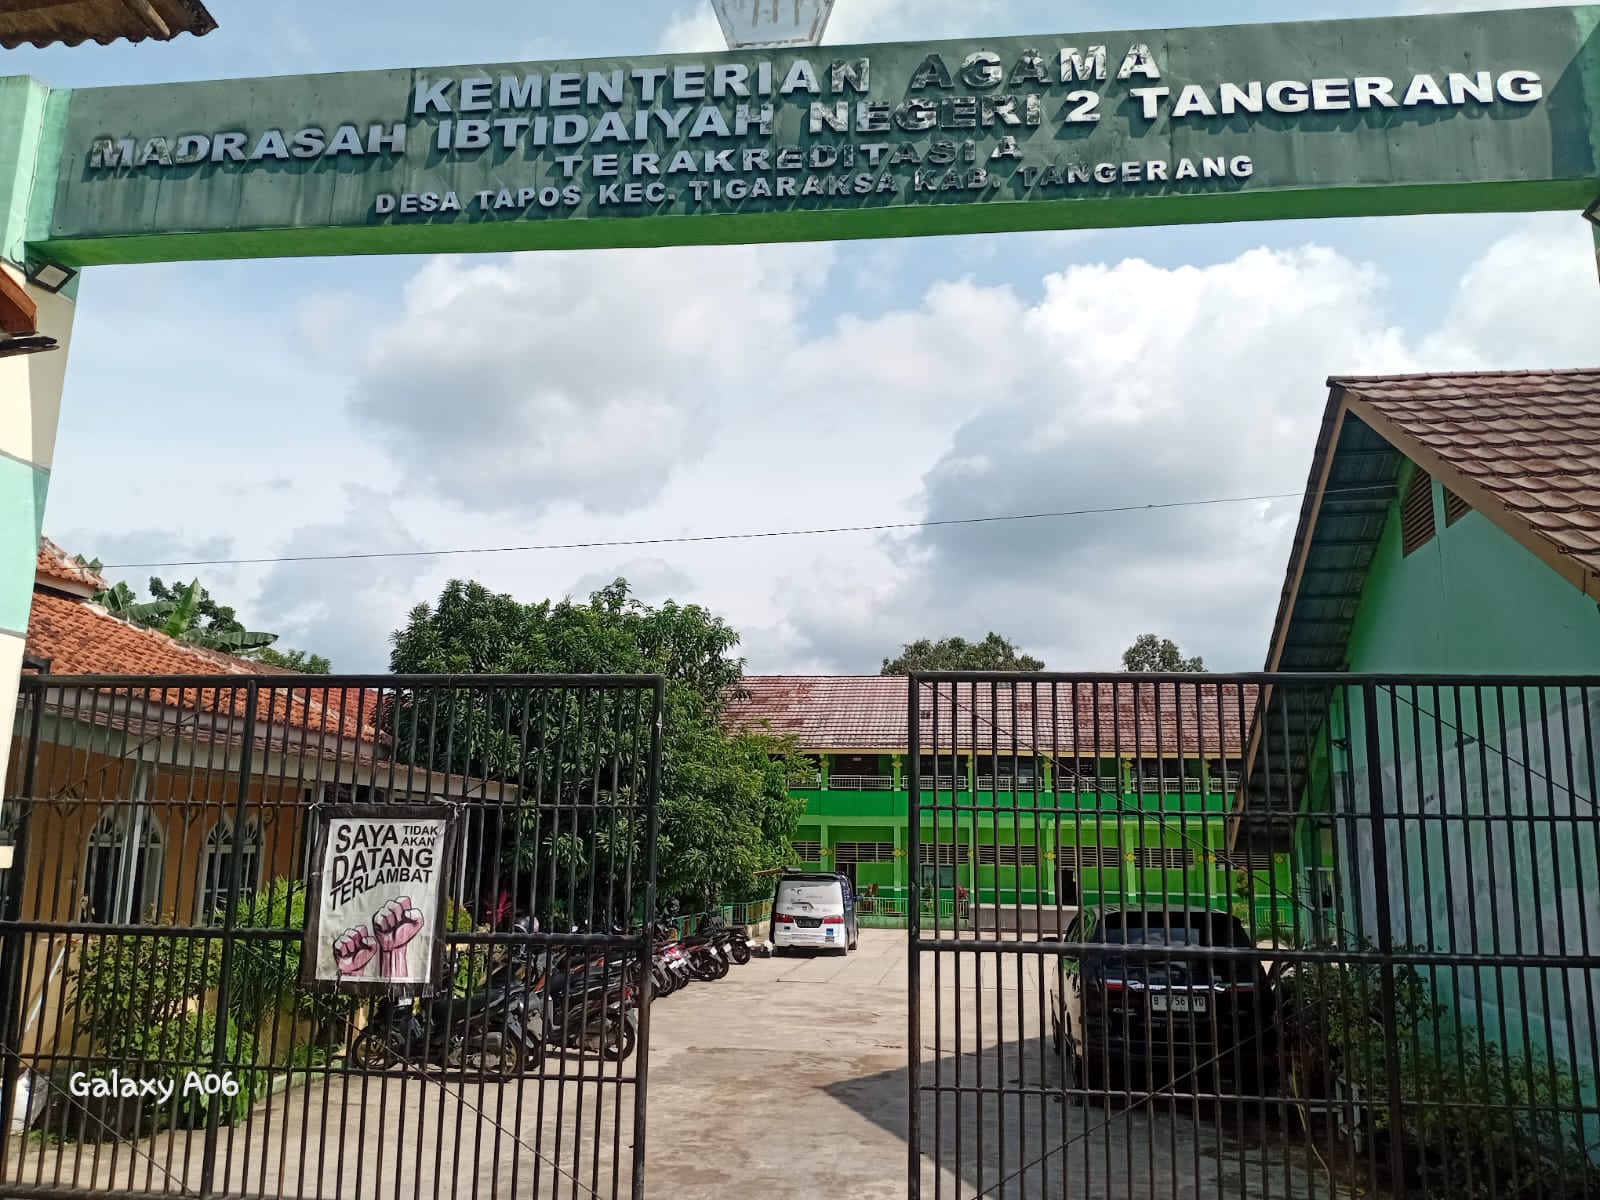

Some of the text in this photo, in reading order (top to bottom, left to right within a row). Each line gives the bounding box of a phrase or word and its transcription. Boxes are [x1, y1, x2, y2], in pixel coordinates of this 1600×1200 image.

[413, 43, 1162, 114] KEMENTERIAN AGAMA
[89, 70, 1544, 169] MADRASAH IBTIDAIYAH NEGERI 2 TANGERANG
[555, 135, 1024, 178] TERAKREDITASI A
[375, 155, 1255, 214] DESA TAPOS KEC. TIGARAKSA KAB. TANGERANG
[335, 824, 438, 853] SAYA TIDAK
[401, 836, 436, 847] AKAN
[329, 867, 433, 911] TERLAMBAT
[332, 848, 433, 889] DATANG
